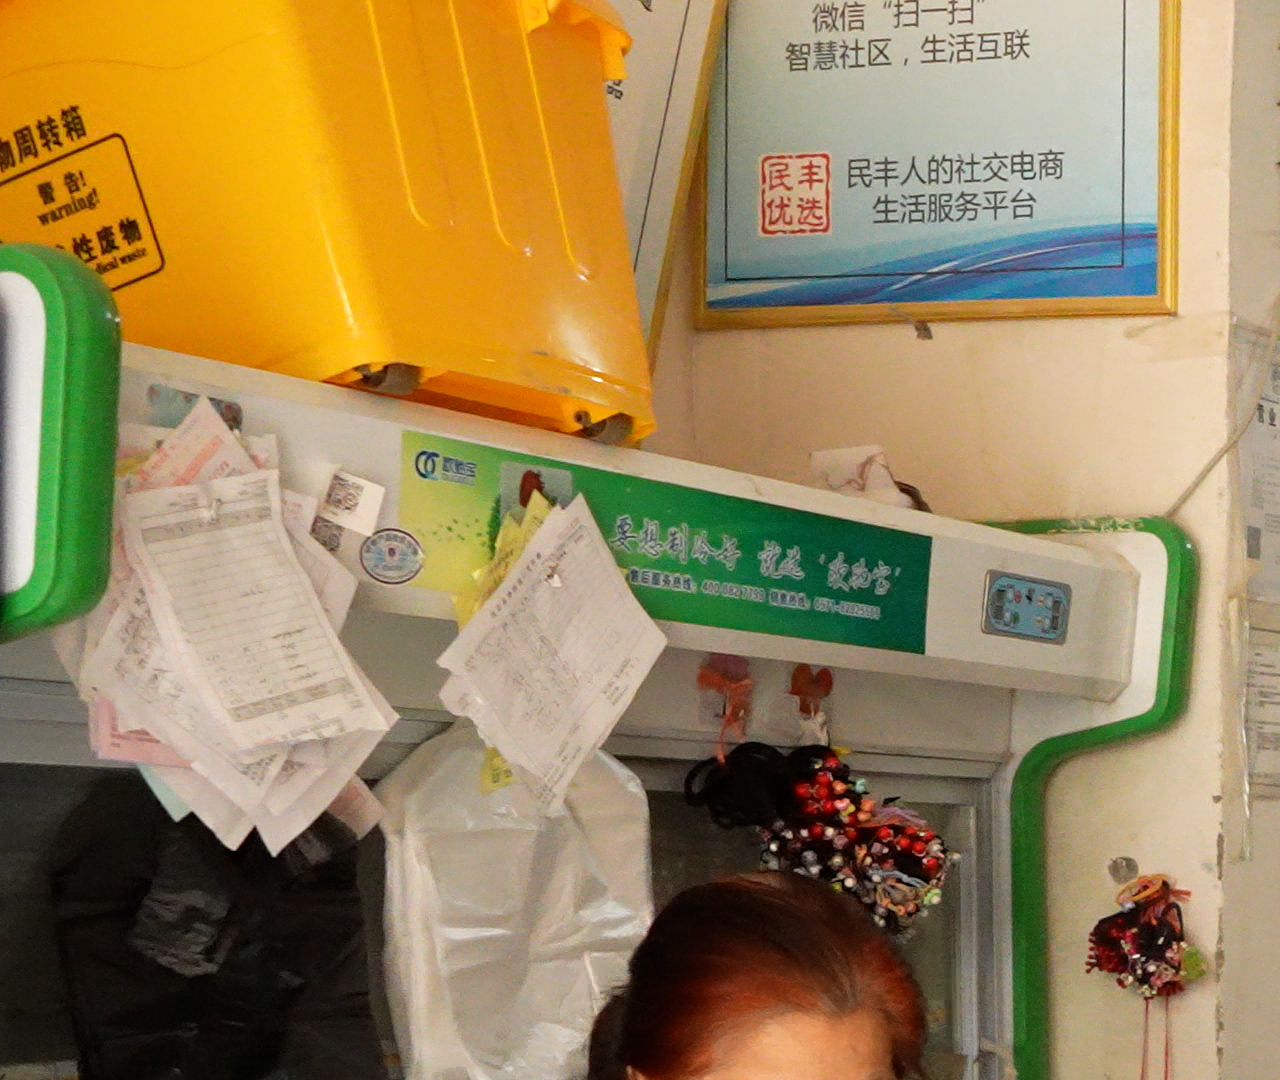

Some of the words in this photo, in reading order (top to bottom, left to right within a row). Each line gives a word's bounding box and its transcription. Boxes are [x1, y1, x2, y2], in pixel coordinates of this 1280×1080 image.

[785, 30, 1031, 72] 智慧社区，生活互联
[847, 149, 1065, 188] 民丰人的社交电商
[872, 190, 1037, 225] 生活服务平台
[56, 217, 142, 263] 性废物
